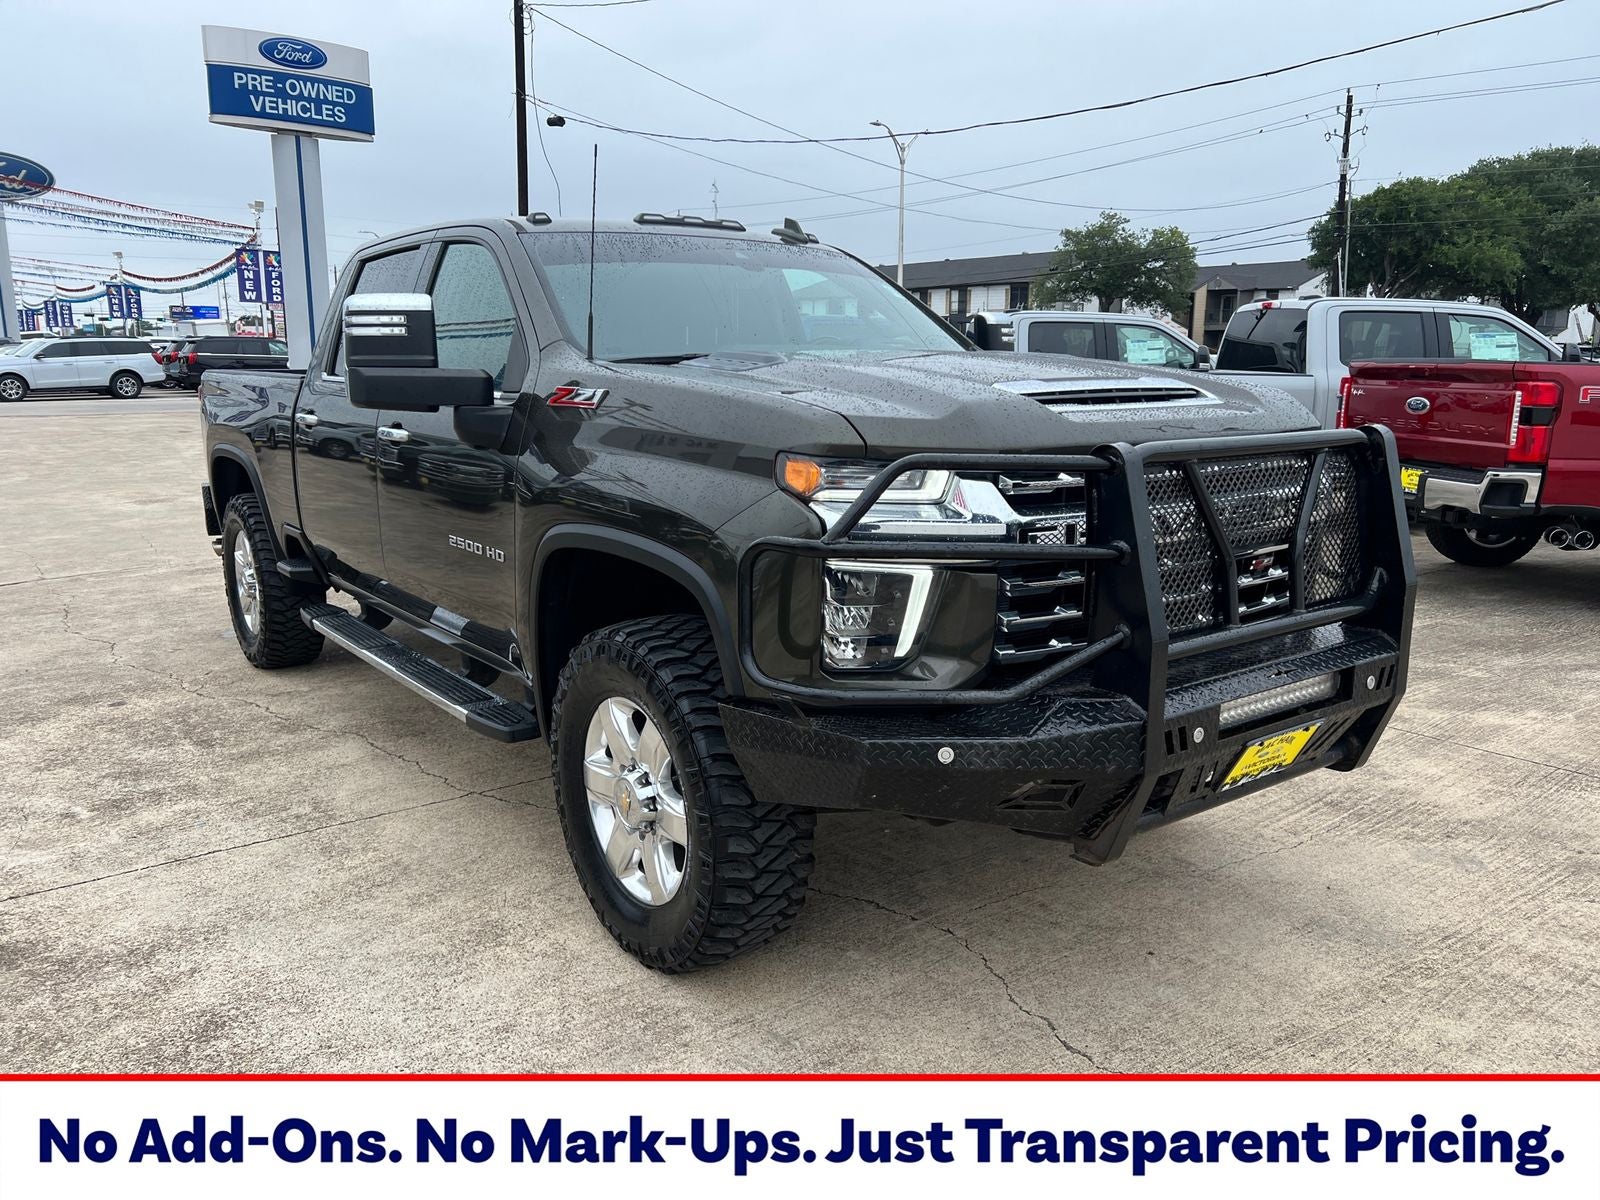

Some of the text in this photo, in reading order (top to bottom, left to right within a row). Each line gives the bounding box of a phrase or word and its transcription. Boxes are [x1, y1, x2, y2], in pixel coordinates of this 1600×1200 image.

[273, 42, 313, 64] Ford
[250, 95, 347, 123] VEHICLES
[243, 270, 257, 300] NEW
[271, 271, 282, 302] FORD
[111, 298, 121, 318] NEW
[129, 299, 139, 318] FORD
[547, 386, 609, 409] Z71
[1427, 421, 1496, 435] DUTY
[448, 534, 505, 563] 2500 HD
